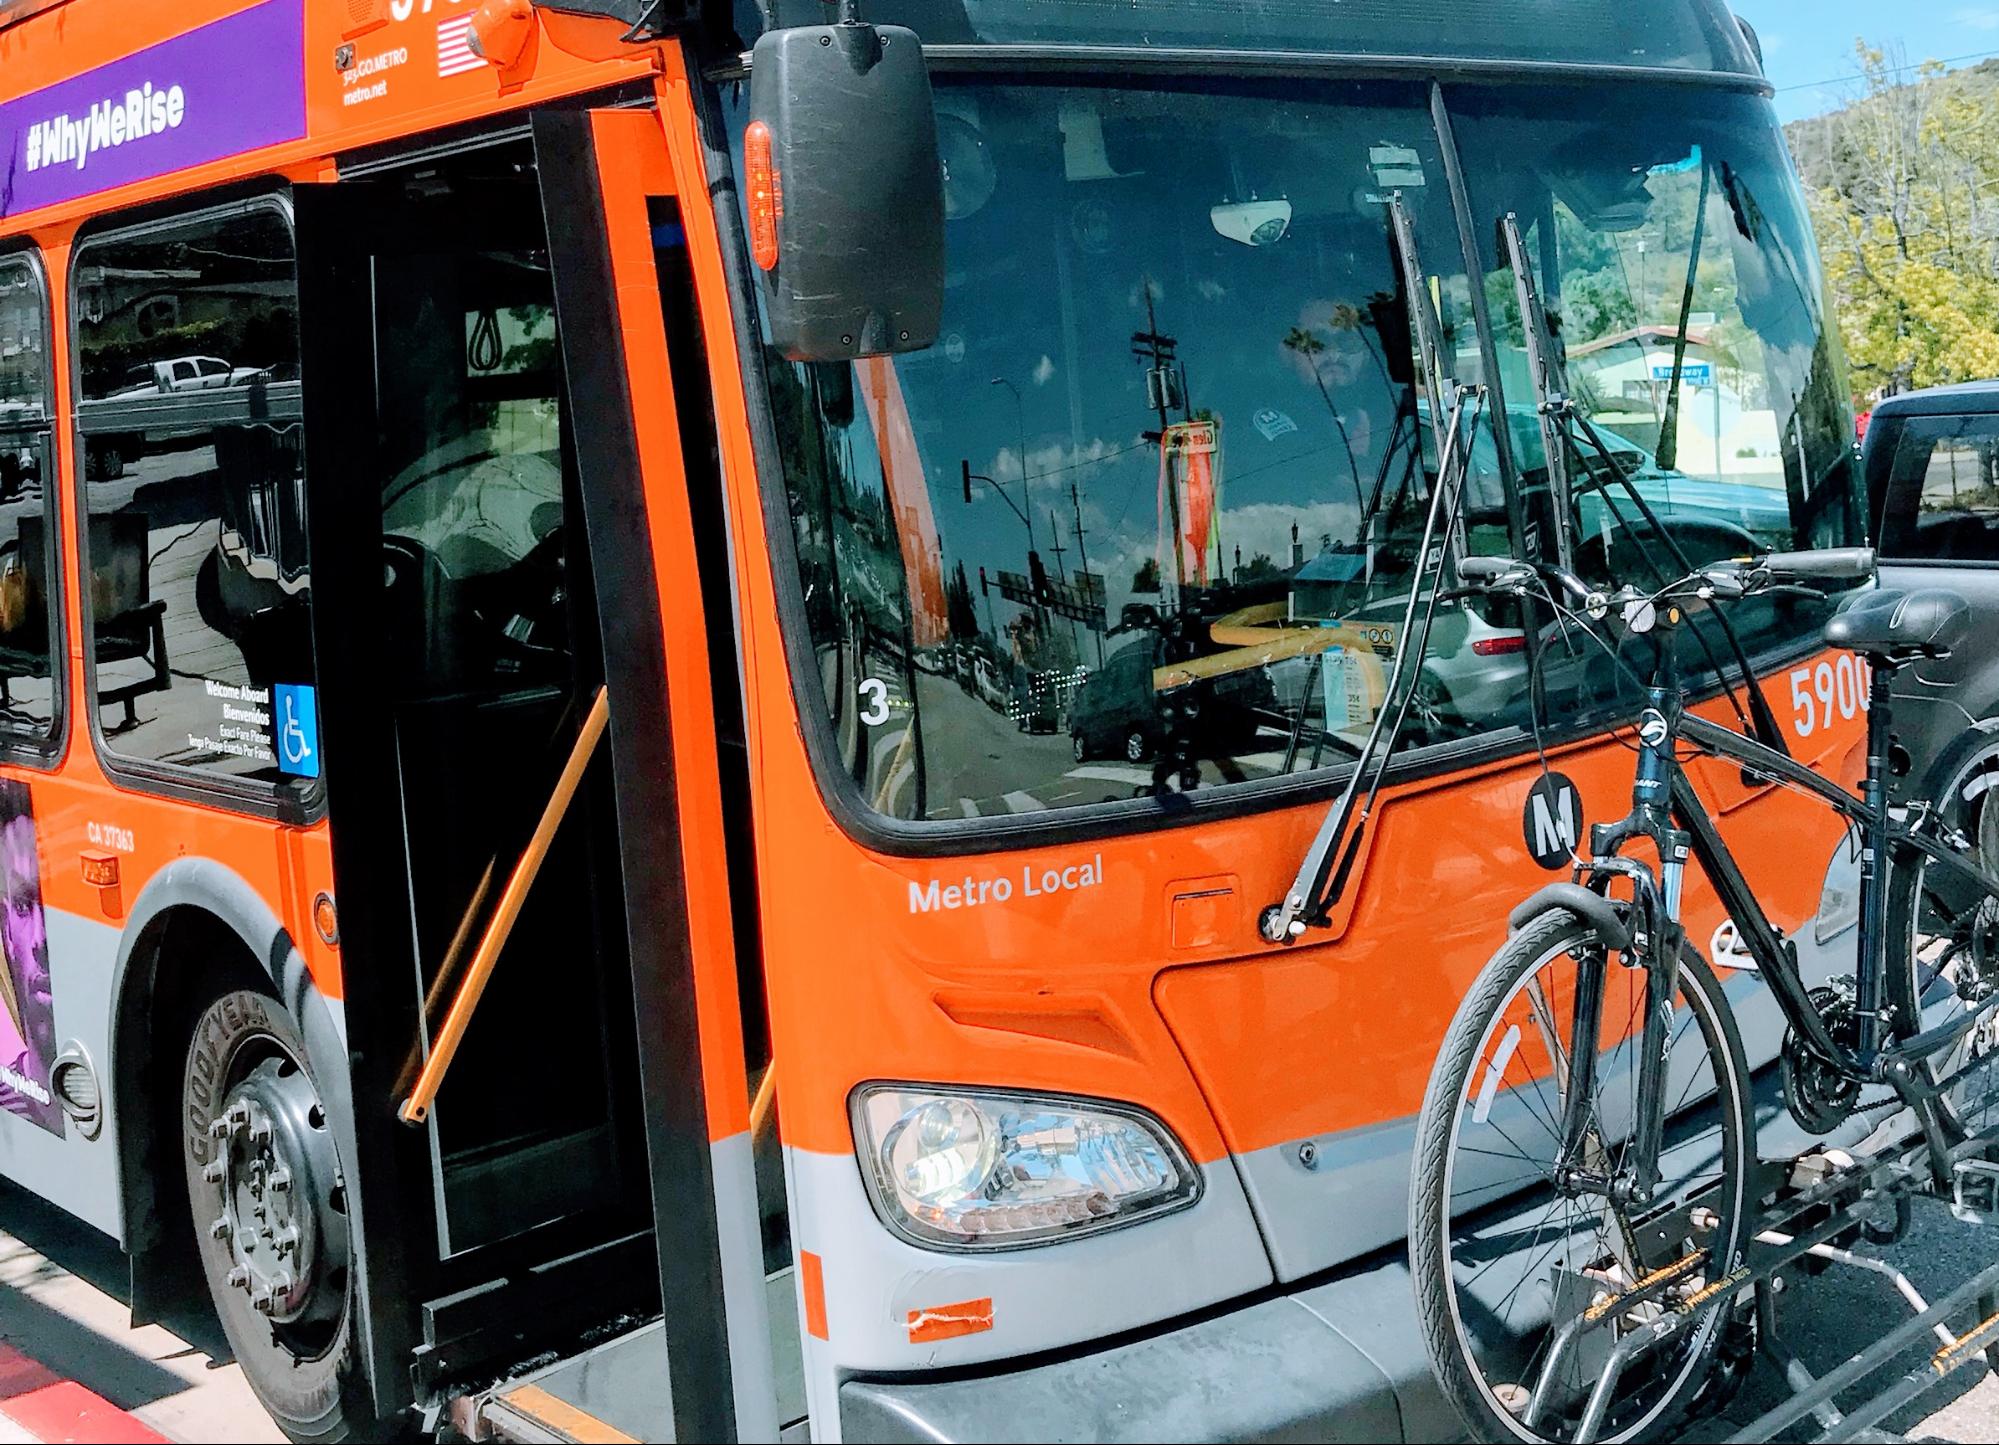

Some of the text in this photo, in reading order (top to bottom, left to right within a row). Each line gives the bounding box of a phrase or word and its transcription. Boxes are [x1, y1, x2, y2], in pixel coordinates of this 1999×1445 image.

[343, 79, 387, 106] metro.net
[27, 81, 185, 172] #WhyWeRise
[1658, 366, 1703, 380] Brodway
[204, 680, 269, 704] Welcome Aboard
[858, 677, 891, 726] 3
[1790, 654, 1872, 737] 5900
[223, 703, 270, 726] Bienvenidos
[219, 724, 271, 745] Exact Fare Please
[87, 821, 102, 844] CA
[908, 853, 1103, 914] Metro Local
